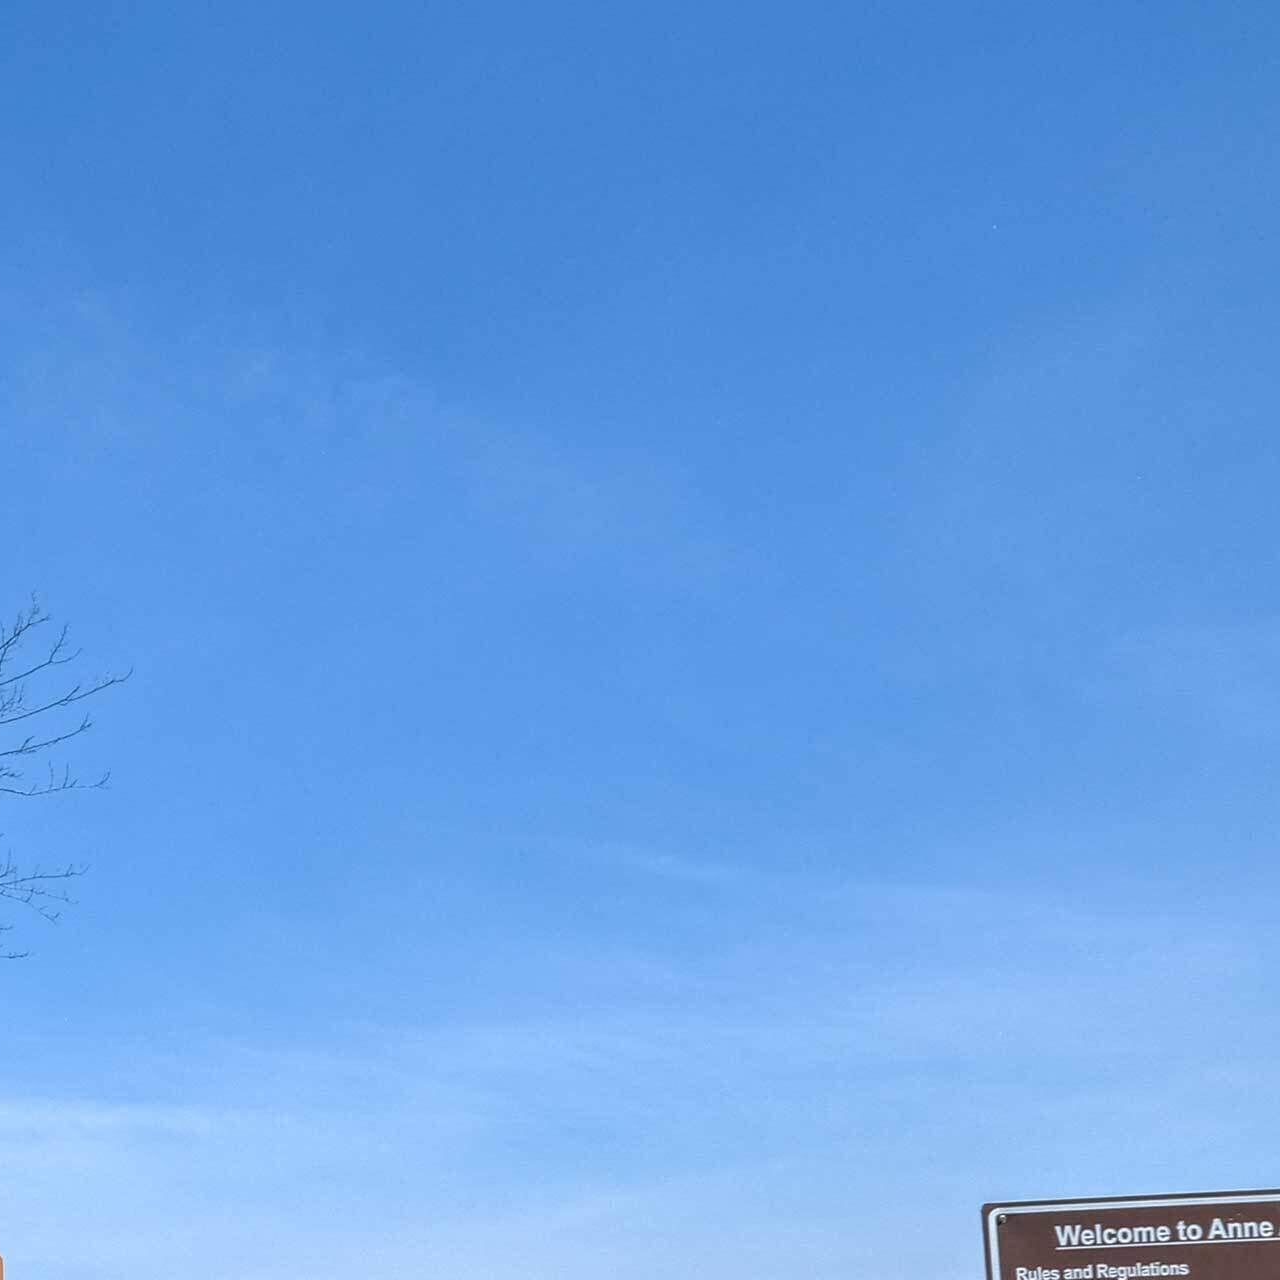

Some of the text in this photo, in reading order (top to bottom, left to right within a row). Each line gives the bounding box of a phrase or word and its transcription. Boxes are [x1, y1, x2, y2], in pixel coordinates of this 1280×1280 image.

[1055, 1224, 1171, 1246] Welcome
[1176, 1220, 1203, 1240] to
[1208, 1218, 1274, 1239] Anne
[1063, 1264, 1093, 1279] and
[1096, 1261, 1190, 1280] Regulations
